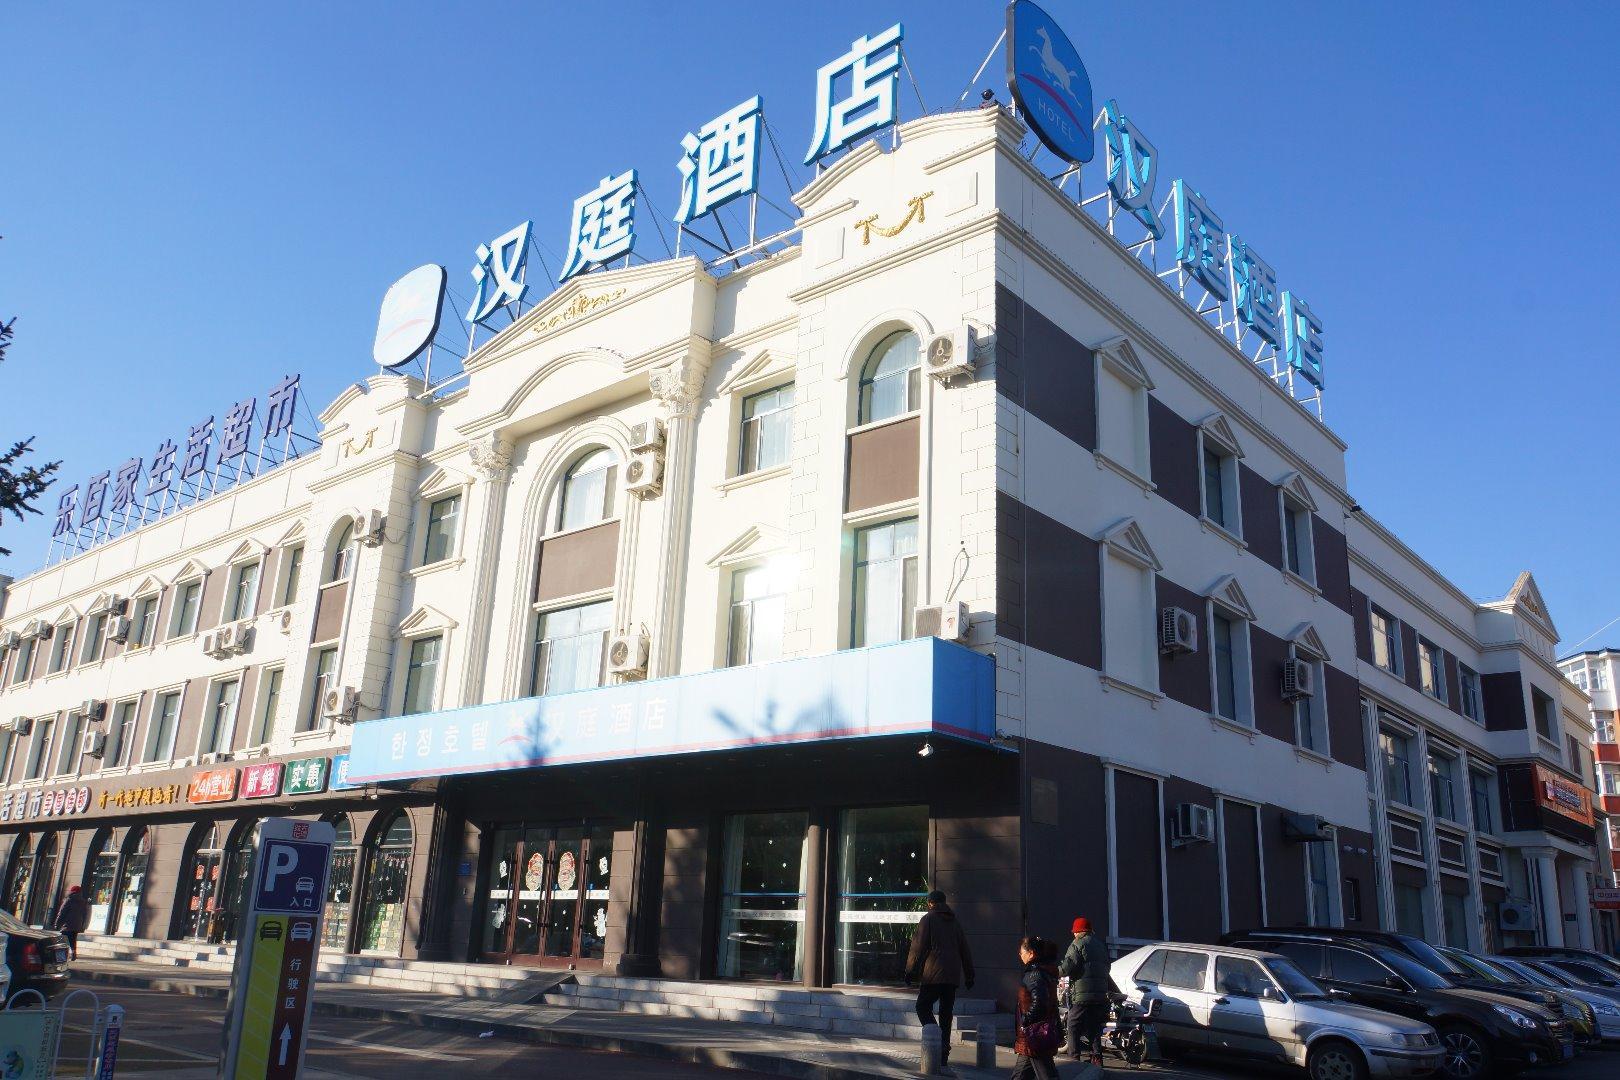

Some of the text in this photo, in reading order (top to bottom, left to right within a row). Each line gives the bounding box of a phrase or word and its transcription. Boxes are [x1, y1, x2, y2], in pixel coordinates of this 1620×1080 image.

[1038, 97, 1075, 142] HOTEL
[465, 22, 904, 323] 汉庭酒店
[1104, 99, 1325, 390] 汉庭酒店
[53, 373, 300, 537] 乐百家生活超市
[391, 719, 489, 760] 한정호텔
[247, 768, 275, 792] 新鲜
[291, 763, 321, 788] 实惠
[264, 845, 298, 891] P
[290, 897, 312, 907] 入口
[285, 958, 301, 1009] 行驶区
